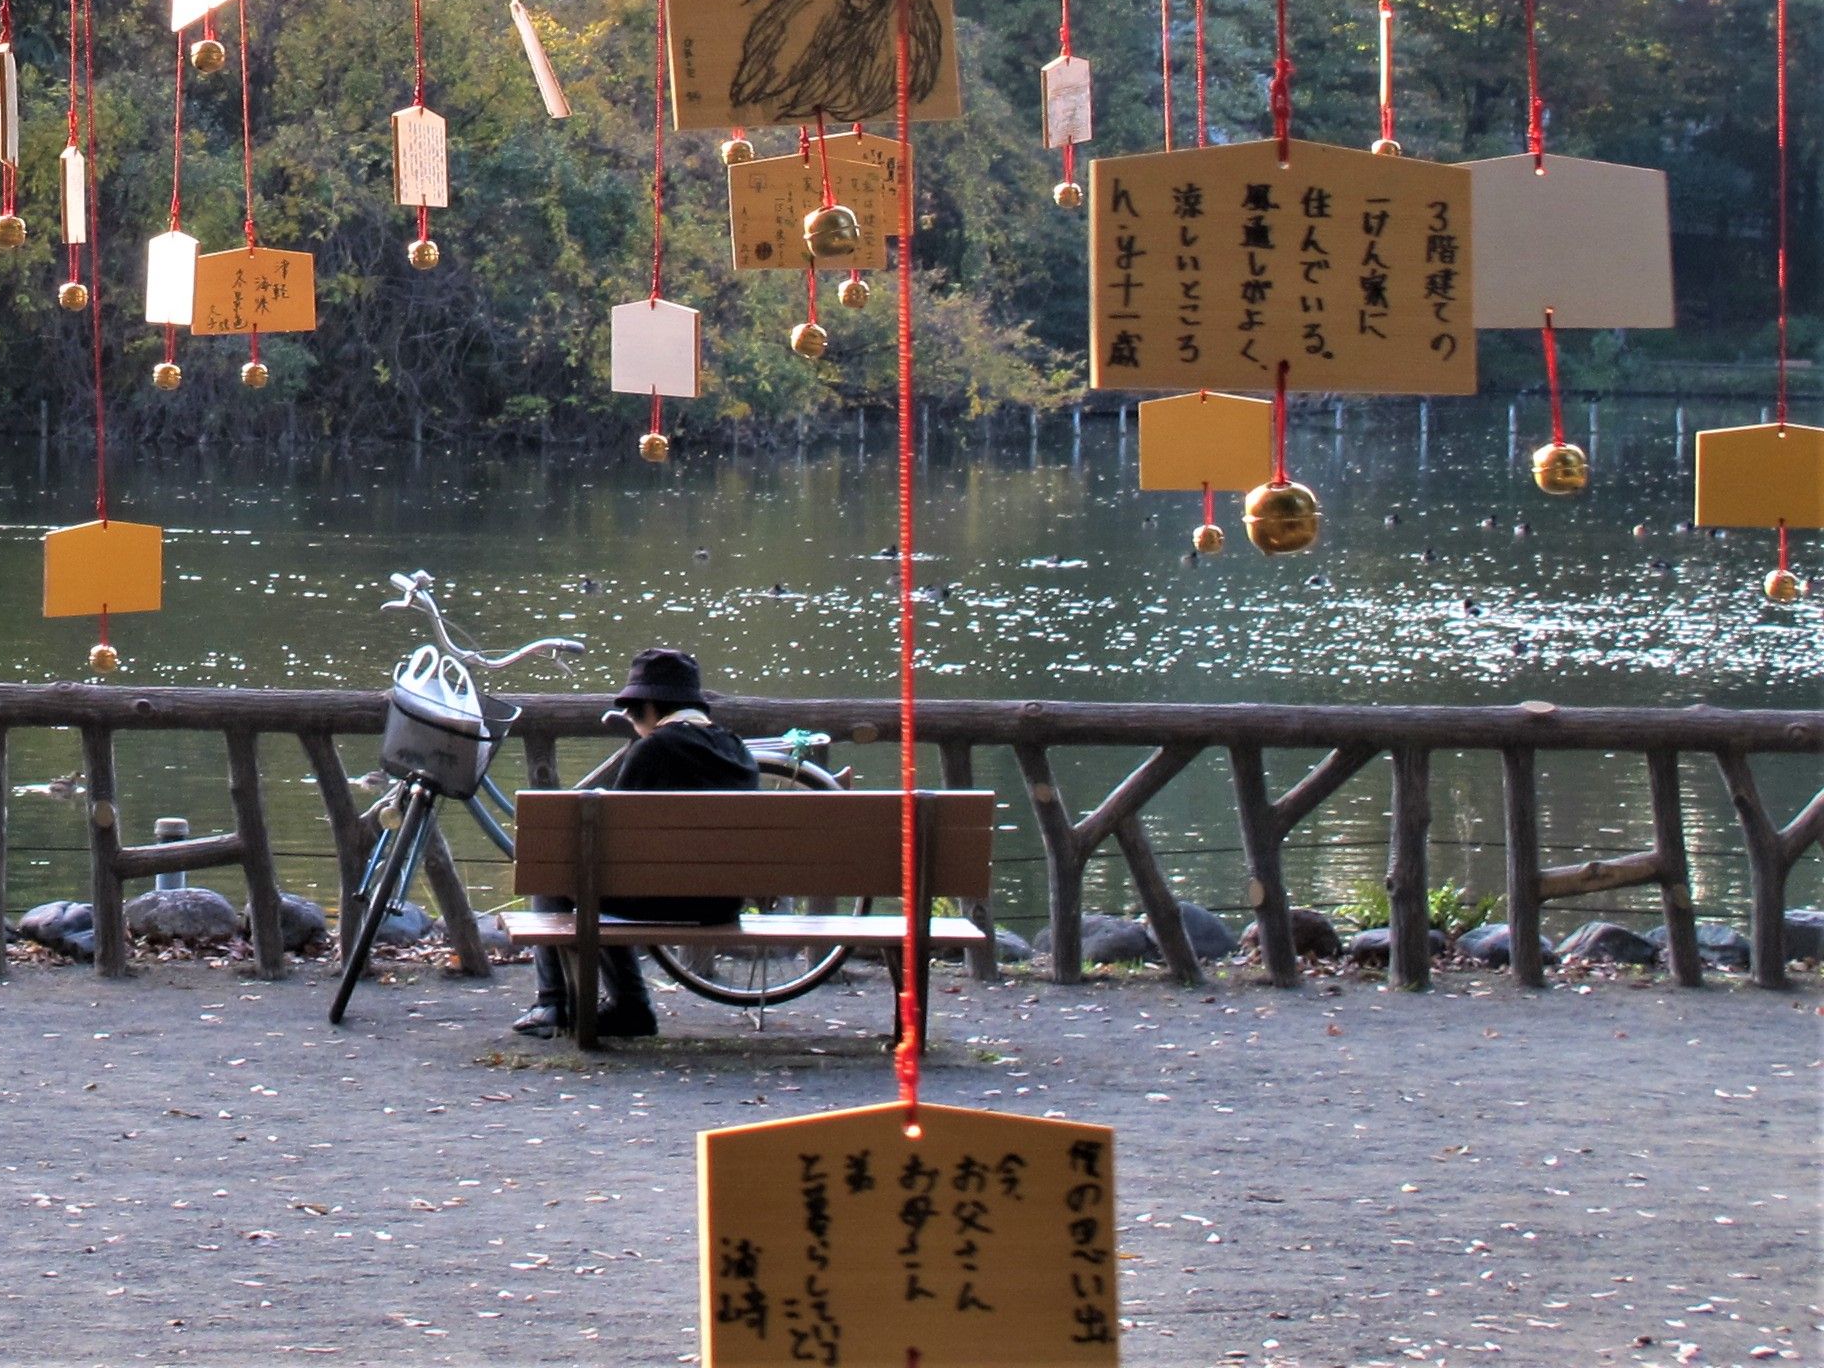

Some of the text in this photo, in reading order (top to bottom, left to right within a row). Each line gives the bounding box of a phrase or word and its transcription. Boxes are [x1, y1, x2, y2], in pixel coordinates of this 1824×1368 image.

[1171, 183, 1207, 367] 涼しいところ
[1238, 182, 1281, 372] 風通しがよく、
[1298, 185, 1335, 362] 住んでいる。
[1357, 196, 1393, 341] 一けん家に
[1422, 198, 1461, 364] 3階建ての
[895, 1152, 941, 1303] お母さん
[952, 1154, 994, 1313] お父さん
